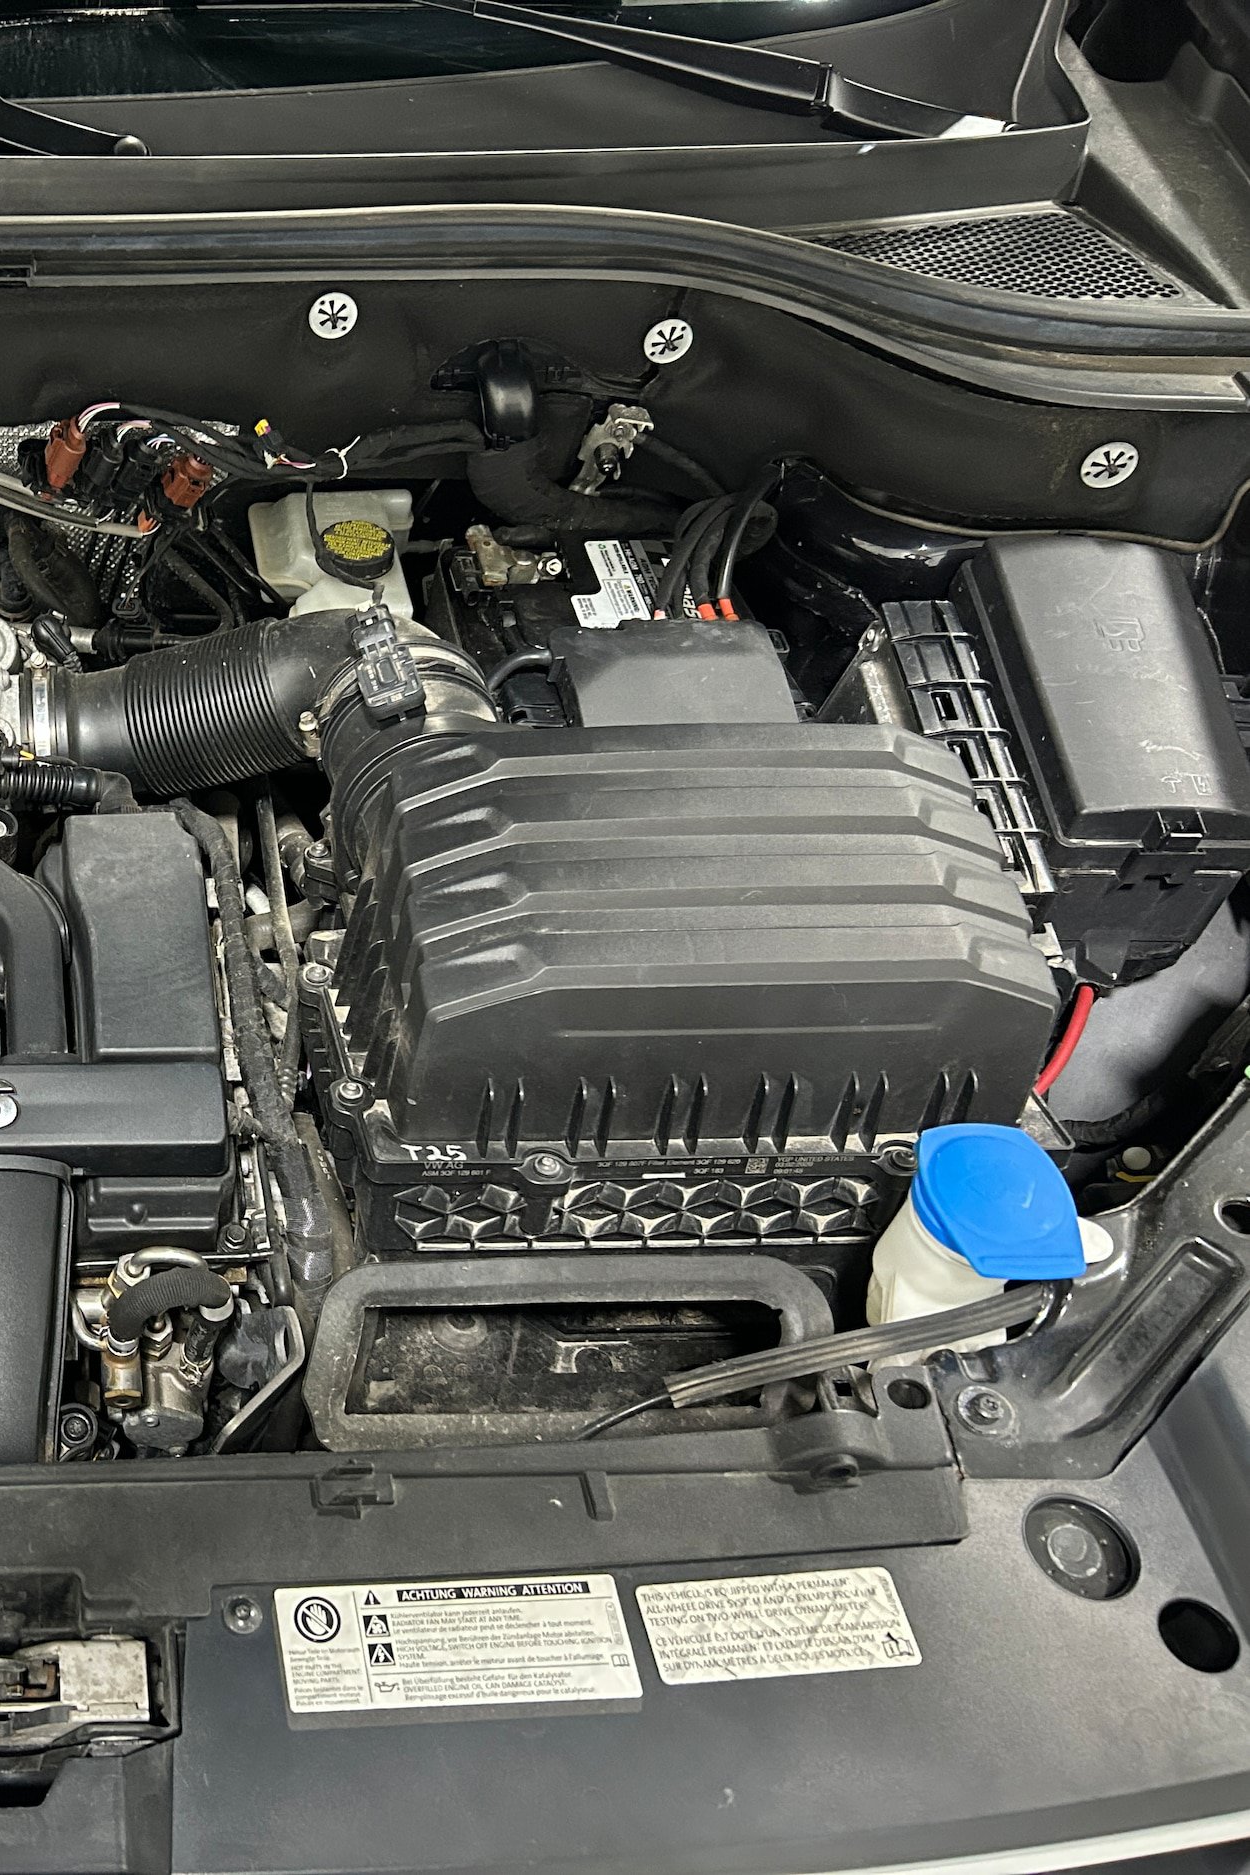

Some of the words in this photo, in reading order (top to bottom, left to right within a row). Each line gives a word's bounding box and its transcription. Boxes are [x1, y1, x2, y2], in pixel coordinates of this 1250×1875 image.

[400, 1144, 467, 1161] T25
[424, 1161, 445, 1169] VW
[447, 1161, 464, 1169] AG
[401, 1588, 457, 1601] ACHTUNG
[461, 1585, 517, 1598] WARNING
[522, 1582, 583, 1596] ATTENTION
[641, 1592, 664, 1602] THIS
[698, 1600, 725, 1611] DRIVE
[763, 1594, 784, 1605] AND
[648, 1615, 688, 1627] TESTING
[689, 1613, 705, 1624] ON
